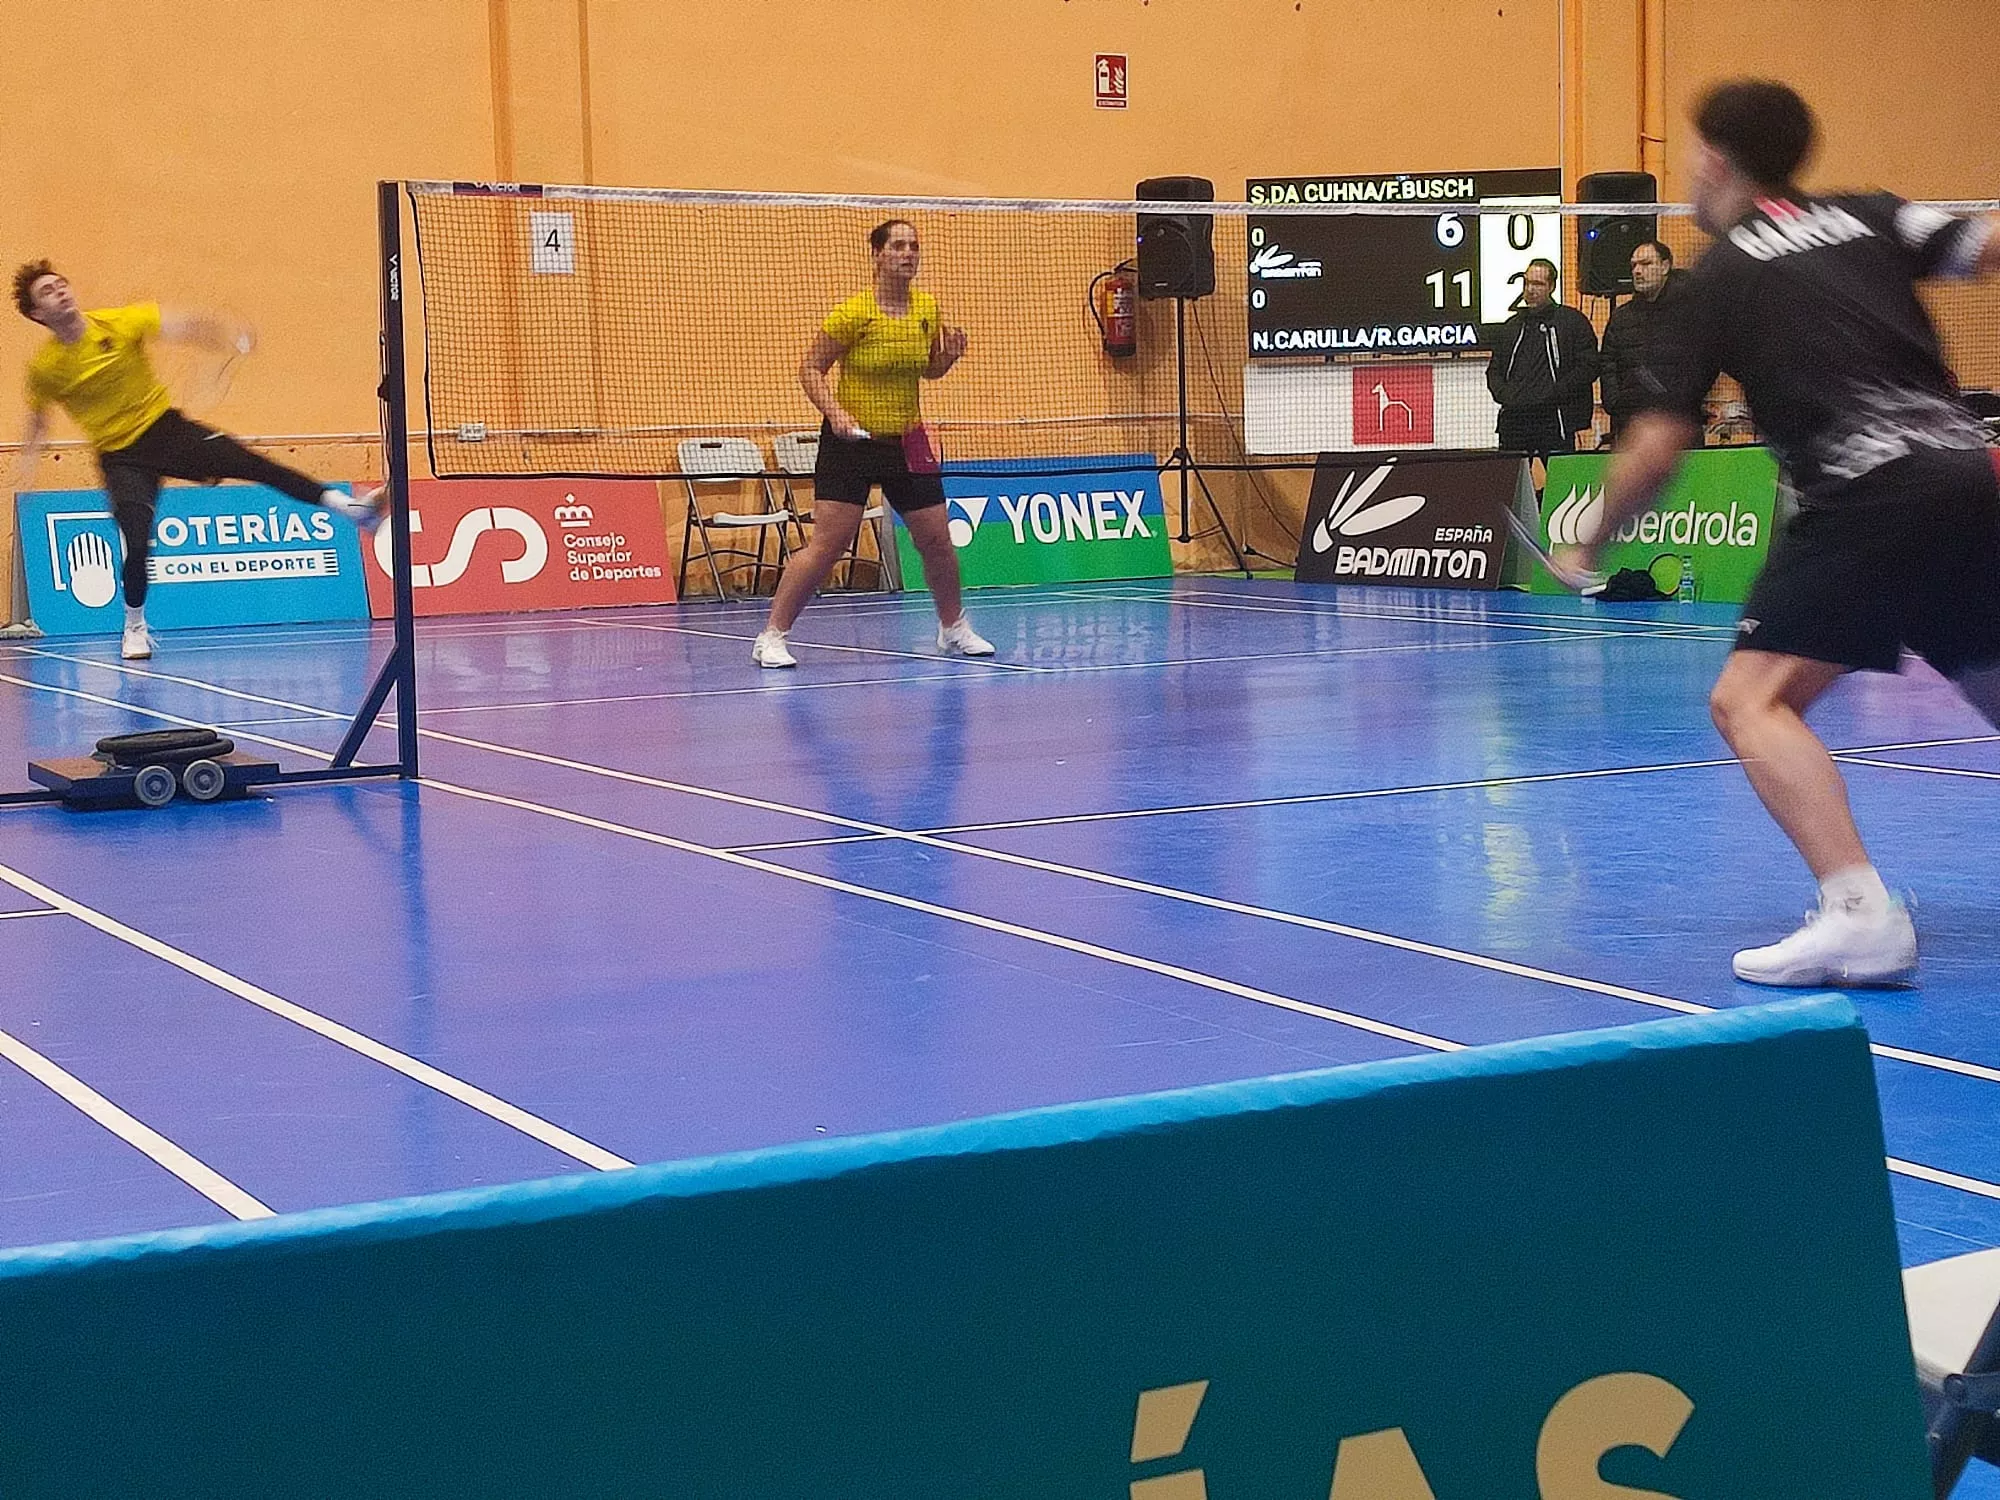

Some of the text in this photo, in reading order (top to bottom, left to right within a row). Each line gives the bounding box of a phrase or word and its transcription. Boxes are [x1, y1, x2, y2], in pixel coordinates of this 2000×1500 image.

[1250, 185, 1300, 204] S.DA
[545, 229, 562, 252] 4
[1251, 227, 1266, 247] 0
[1435, 212, 1534, 250] 6 0
[1251, 289, 1267, 310] 0
[1424, 269, 1473, 308] 11
[1253, 325, 1477, 350] N.CARULLA/R.GARCIA
[148, 507, 334, 548] OTERÍAS
[997, 490, 1152, 544] YONEX
[563, 531, 626, 552] Consejo
[164, 556, 317, 576] CON EL DEPORTE
[567, 549, 633, 567] Superior
[1334, 546, 1487, 580] BADMINTON
[570, 564, 662, 583] de Deportes
